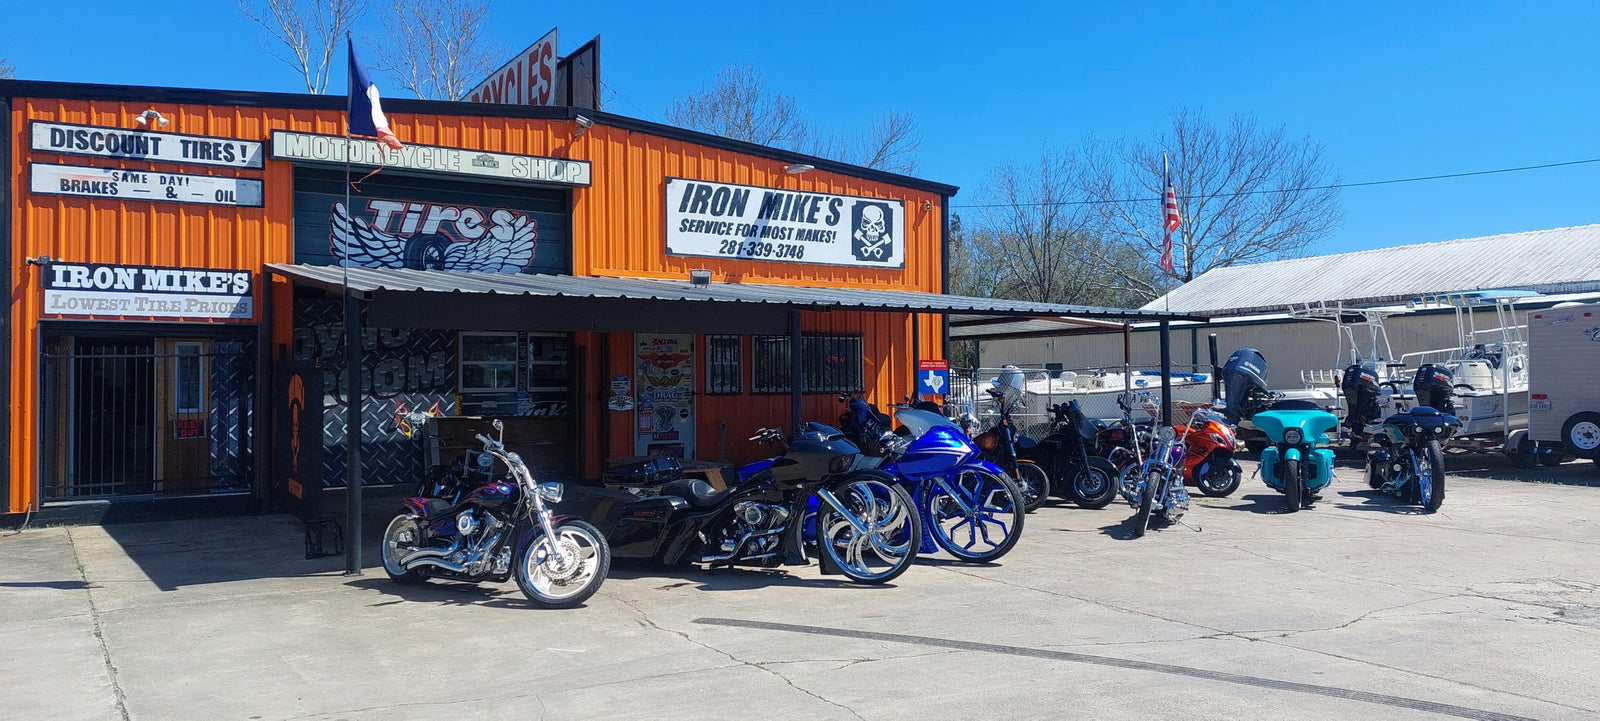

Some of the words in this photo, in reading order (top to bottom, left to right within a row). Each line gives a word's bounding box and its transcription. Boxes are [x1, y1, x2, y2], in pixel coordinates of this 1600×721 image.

[50, 127, 162, 156] DISCOUNT
[284, 132, 461, 172] MOTORCYCLE
[511, 156, 582, 183] SHOP
[59, 177, 119, 196] BRAKES
[165, 186, 178, 199] &
[215, 189, 236, 203] OIL
[112, 171, 148, 184] SAME
[159, 175, 190, 187] DAY!
[678, 182, 751, 218] IRON
[757, 191, 844, 227] MIKE'S
[679, 218, 733, 236] SERVICE
[735, 223, 759, 238] FOR
[760, 225, 795, 241] MOST
[795, 228, 837, 244] MAKES!
[718, 239, 805, 260] 281-339-3748
[51, 264, 139, 290] IRON
[141, 267, 249, 294] MIKE'S
[51, 293, 131, 312] LOWEST
[134, 295, 182, 313] TIRE
[183, 297, 249, 314] PRICES
[653, 391, 679, 400] DRAG
